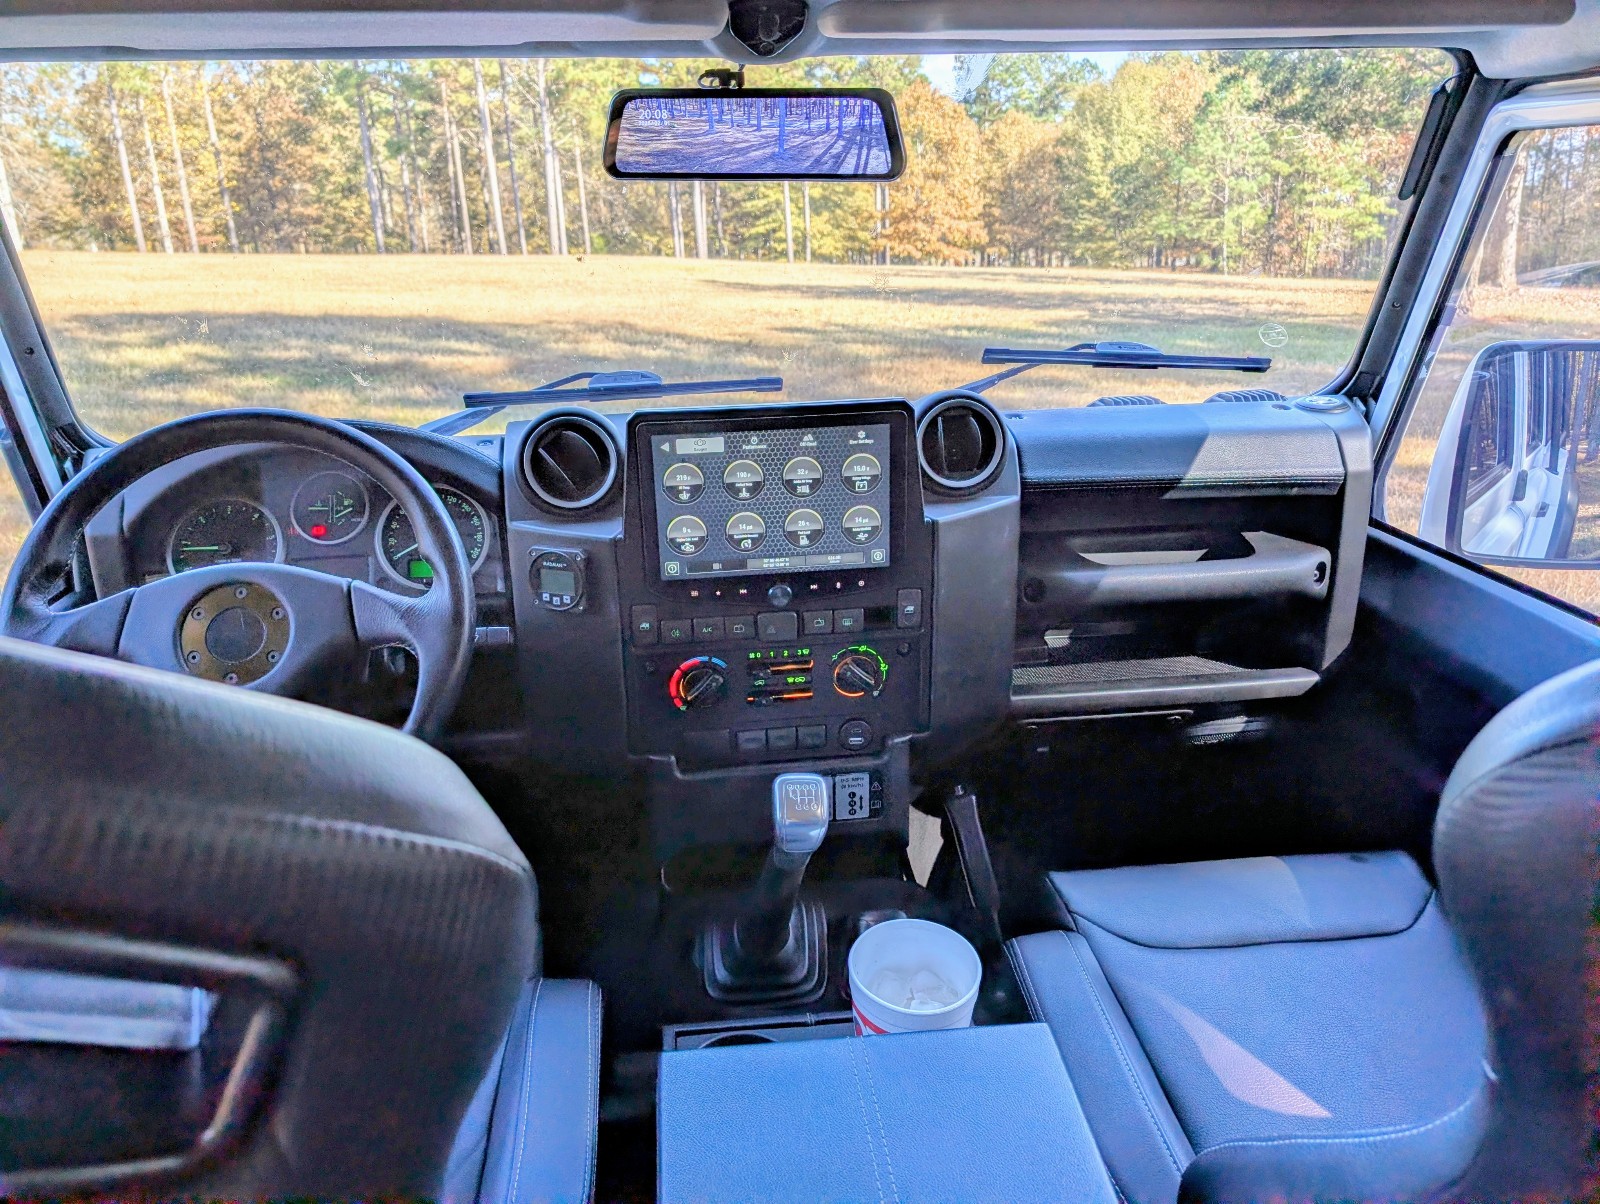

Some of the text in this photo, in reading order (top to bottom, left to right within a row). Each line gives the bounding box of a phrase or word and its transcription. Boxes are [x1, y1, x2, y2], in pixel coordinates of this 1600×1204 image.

[639, 109, 668, 119] 20:08
[447, 495, 457, 503] 120
[391, 521, 398, 529] 40
[388, 537, 395, 545] 20
